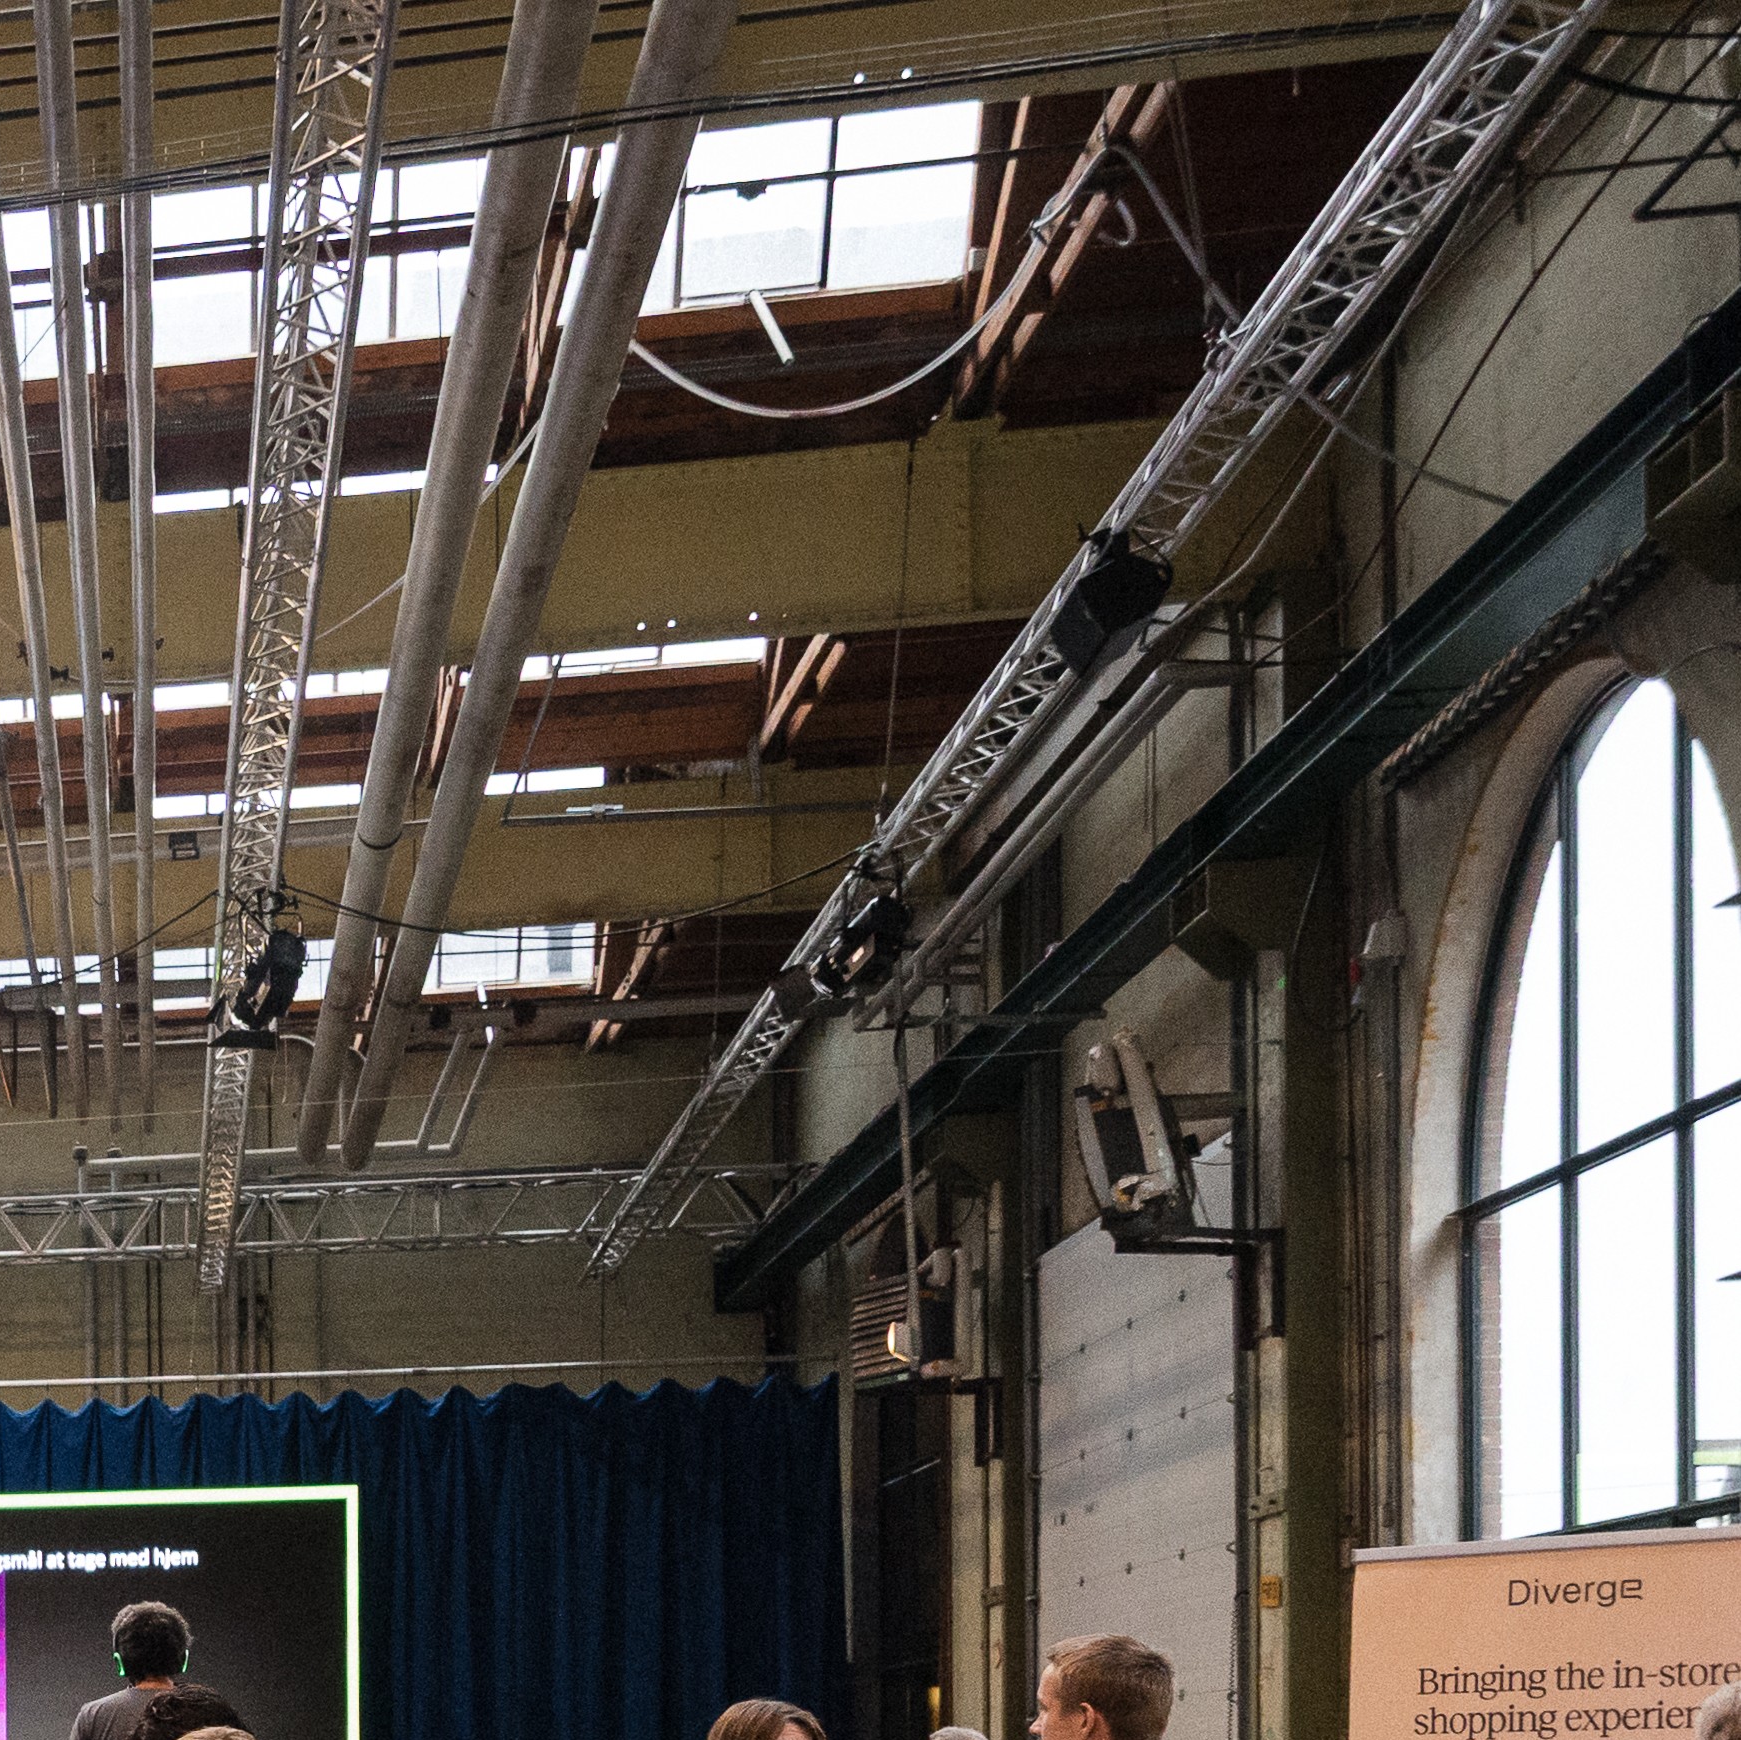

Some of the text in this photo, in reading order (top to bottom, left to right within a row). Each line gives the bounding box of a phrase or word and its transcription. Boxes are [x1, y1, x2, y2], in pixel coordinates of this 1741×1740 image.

[45, 1551, 65, 1570] at
[67, 1550, 106, 1572] tage
[108, 1548, 150, 1568] med
[153, 1547, 199, 1571] hjem
[1508, 1578, 1644, 1608] Diverge
[1417, 1659, 1741, 1700] Bringing the in-store
[1413, 1704, 1557, 1740] shopping
